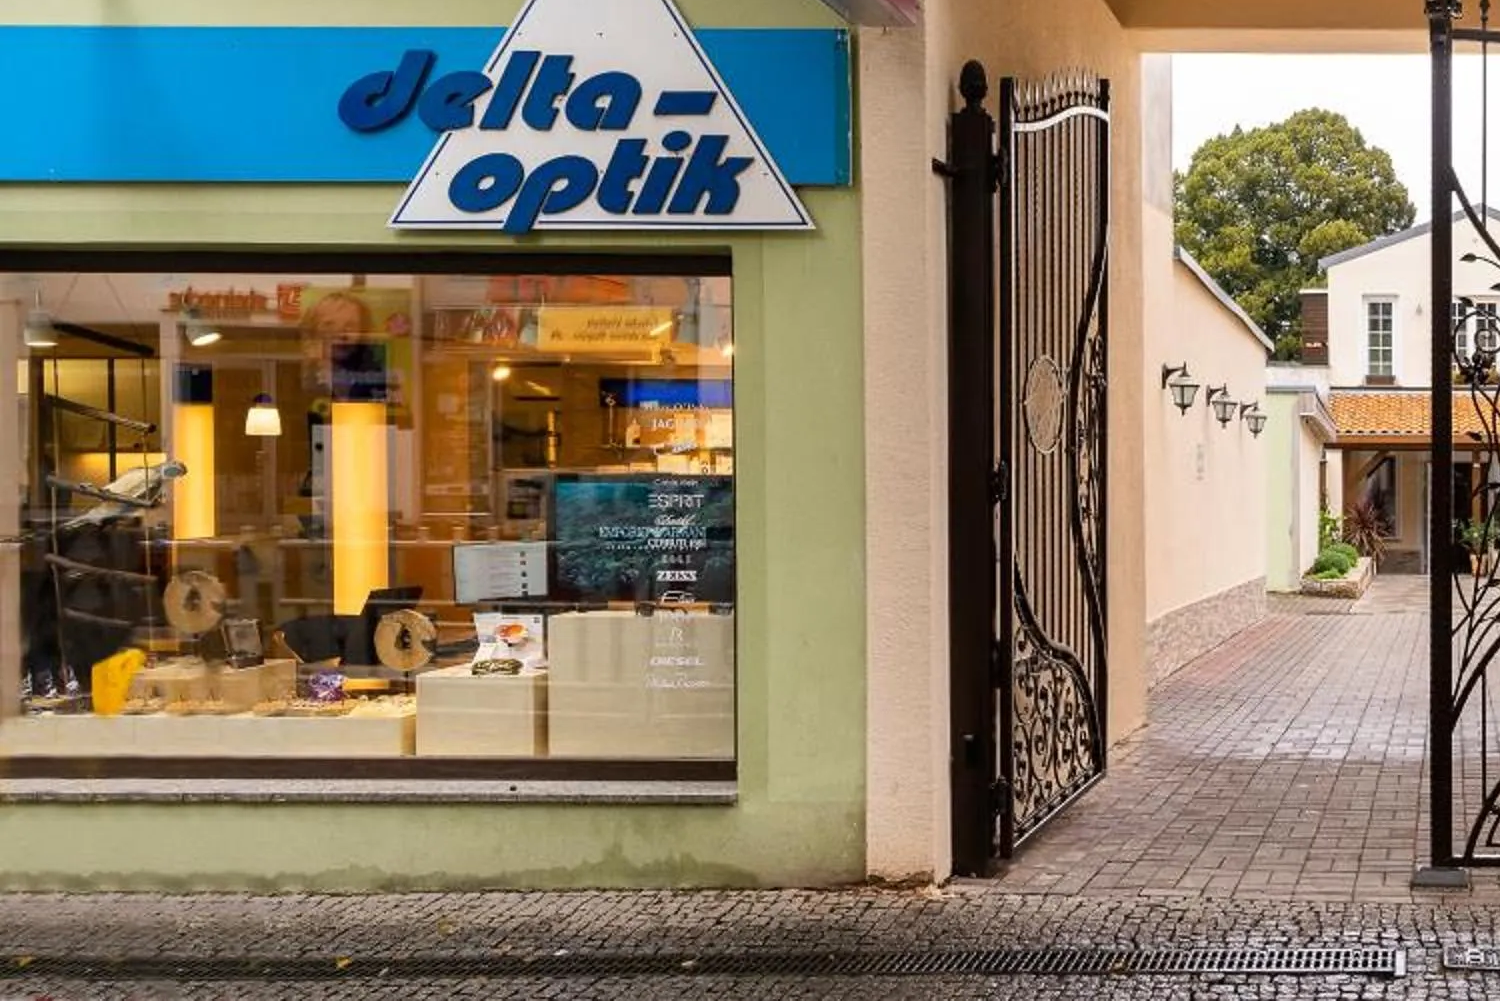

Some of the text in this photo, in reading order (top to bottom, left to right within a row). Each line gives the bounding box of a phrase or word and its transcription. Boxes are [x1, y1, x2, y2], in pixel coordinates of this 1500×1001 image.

[448, 130, 755, 237] optik
[648, 494, 704, 508] ESPRIT
[656, 570, 697, 581] ZEISS
